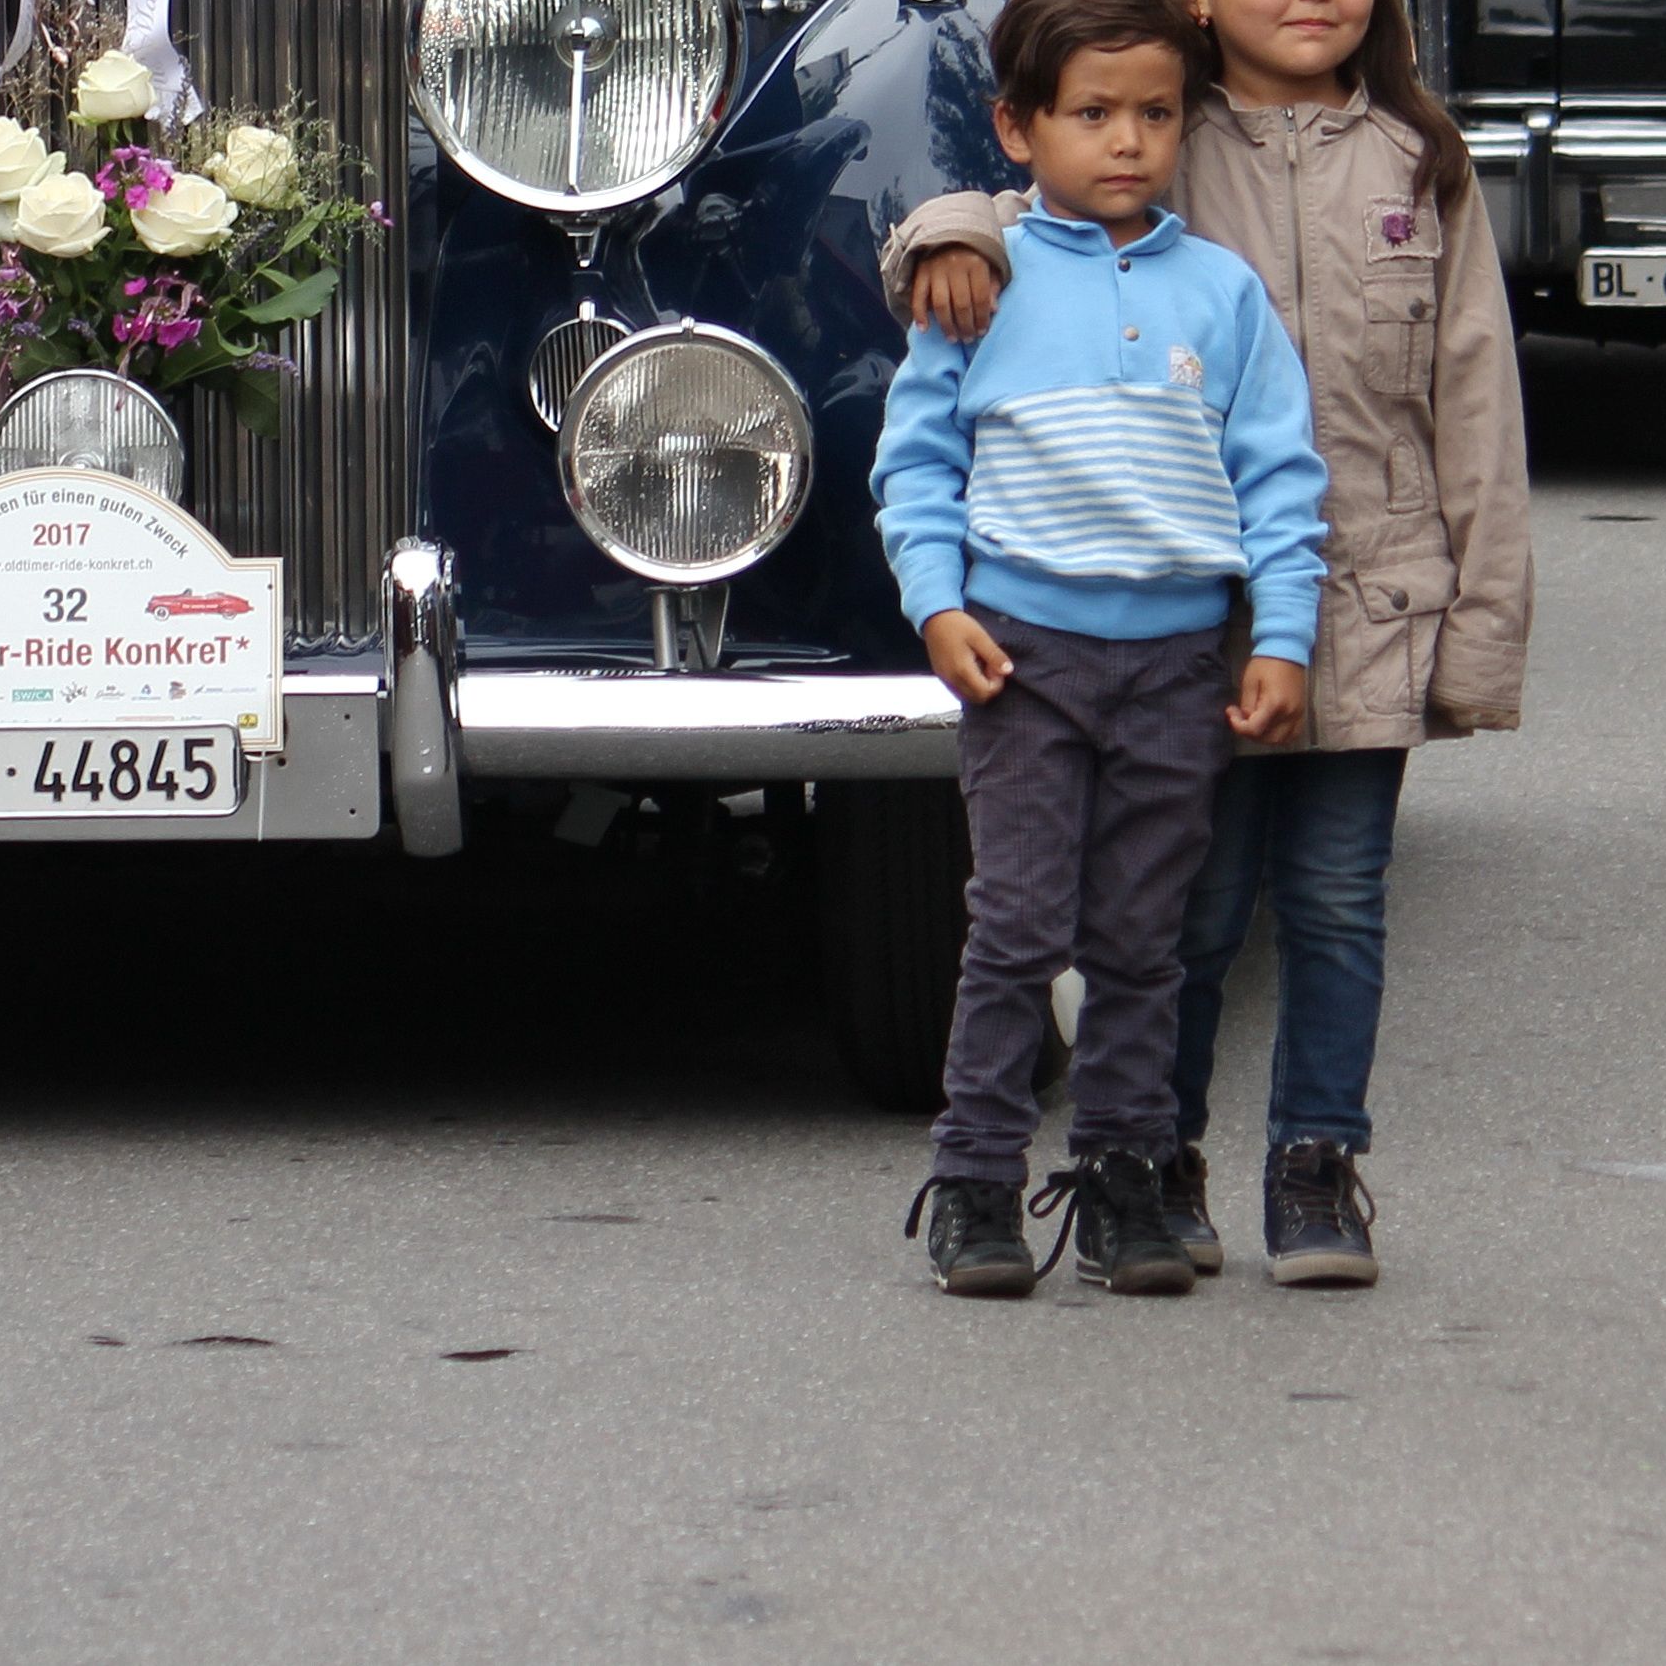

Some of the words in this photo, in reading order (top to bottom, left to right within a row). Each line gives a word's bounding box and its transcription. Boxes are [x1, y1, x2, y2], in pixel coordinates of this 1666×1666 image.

[1592, 261, 1637, 298] BL
[23, 490, 46, 507] für
[52, 488, 95, 506] einen
[100, 495, 144, 524] guten
[144, 516, 189, 559] Zweck
[33, 523, 91, 546] 2017
[43, 588, 89, 623] 32
[33, 738, 217, 803] 44845
